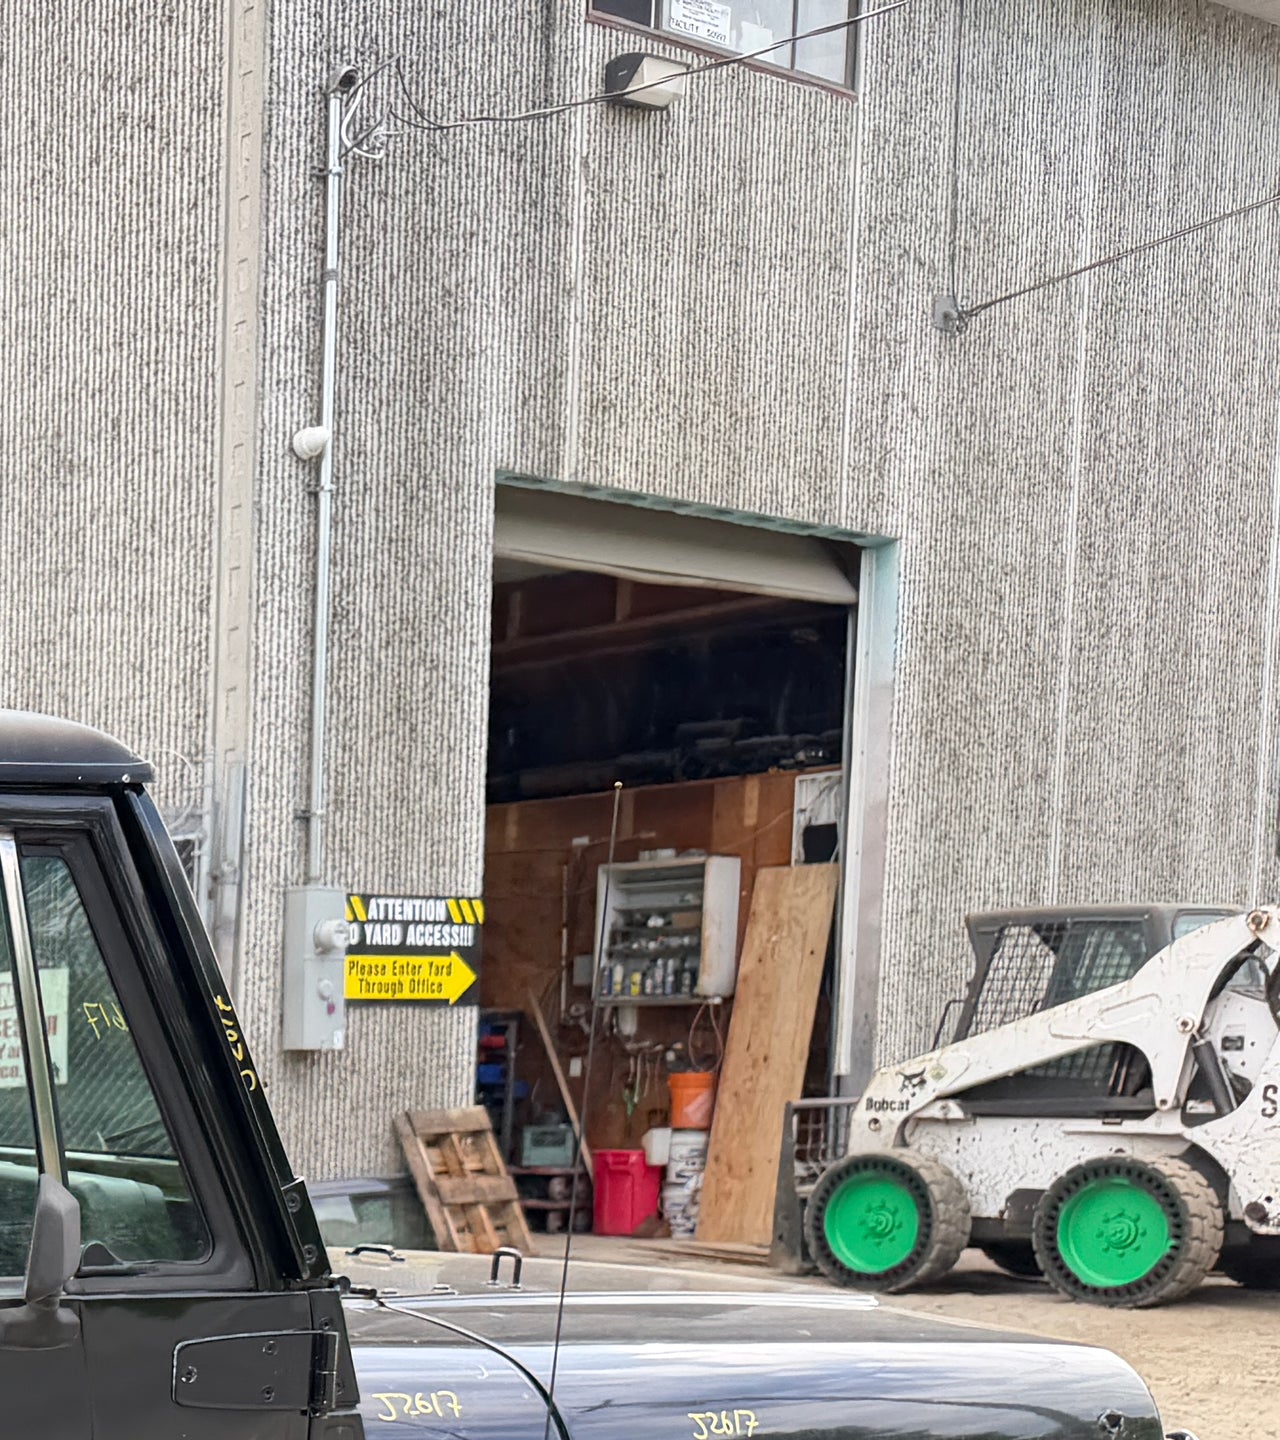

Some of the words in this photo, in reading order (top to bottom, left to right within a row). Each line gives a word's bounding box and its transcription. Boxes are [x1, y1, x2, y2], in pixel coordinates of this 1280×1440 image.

[367, 897, 448, 922] ATTENTION
[364, 923, 402, 946] YARD
[348, 960, 387, 977] Please
[392, 961, 423, 977] Enter
[428, 961, 453, 977] Yard
[358, 978, 404, 997] Through
[409, 978, 443, 994] Office
[865, 1097, 911, 1112] Bobcat
[372, 1389, 463, 1422] J2617
[688, 1410, 759, 1439] J2617
